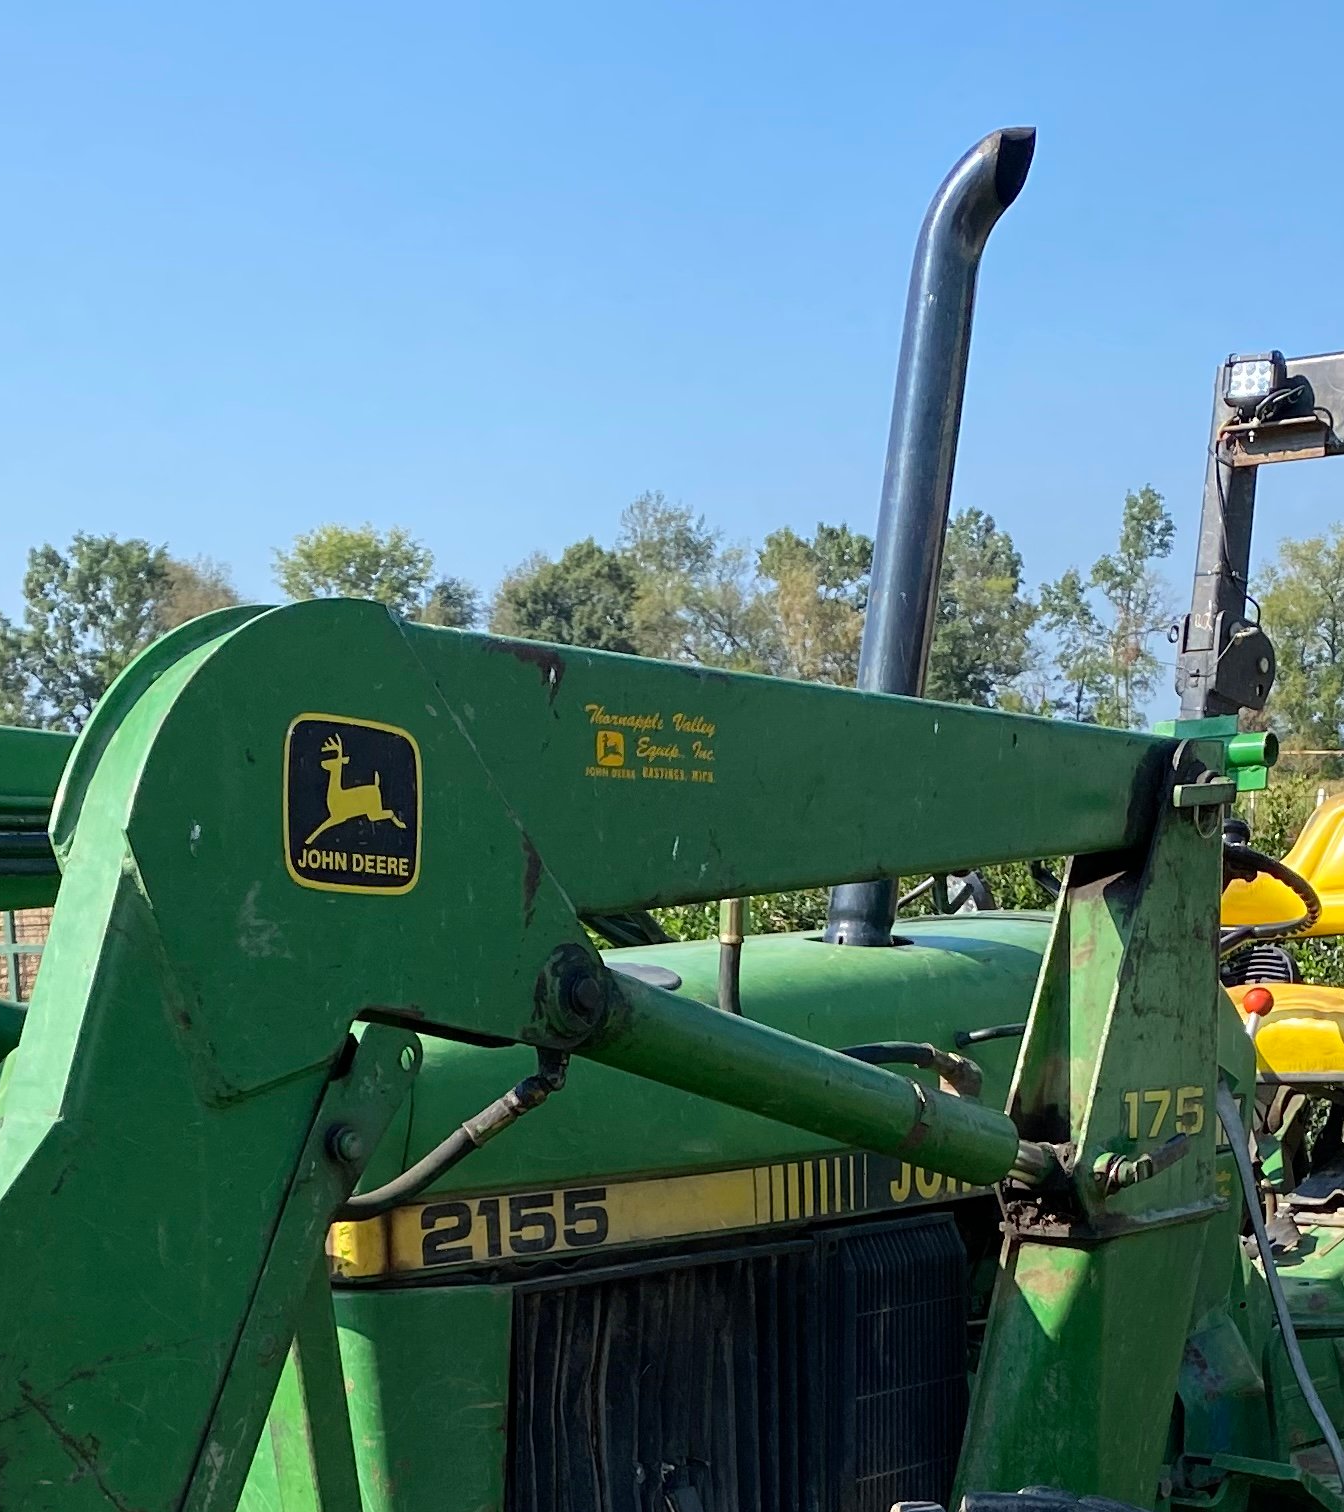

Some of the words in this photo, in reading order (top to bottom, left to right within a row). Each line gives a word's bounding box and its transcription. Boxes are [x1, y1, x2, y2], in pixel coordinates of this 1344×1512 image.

[585, 703, 664, 733] Thornapple
[672, 712, 716, 738] Valley
[585, 765, 609, 777] JOHN
[297, 848, 347, 871] JOHN
[351, 853, 409, 877] DEERE
[1124, 1087, 1204, 1139] 175
[420, 1187, 609, 1266] 2155
